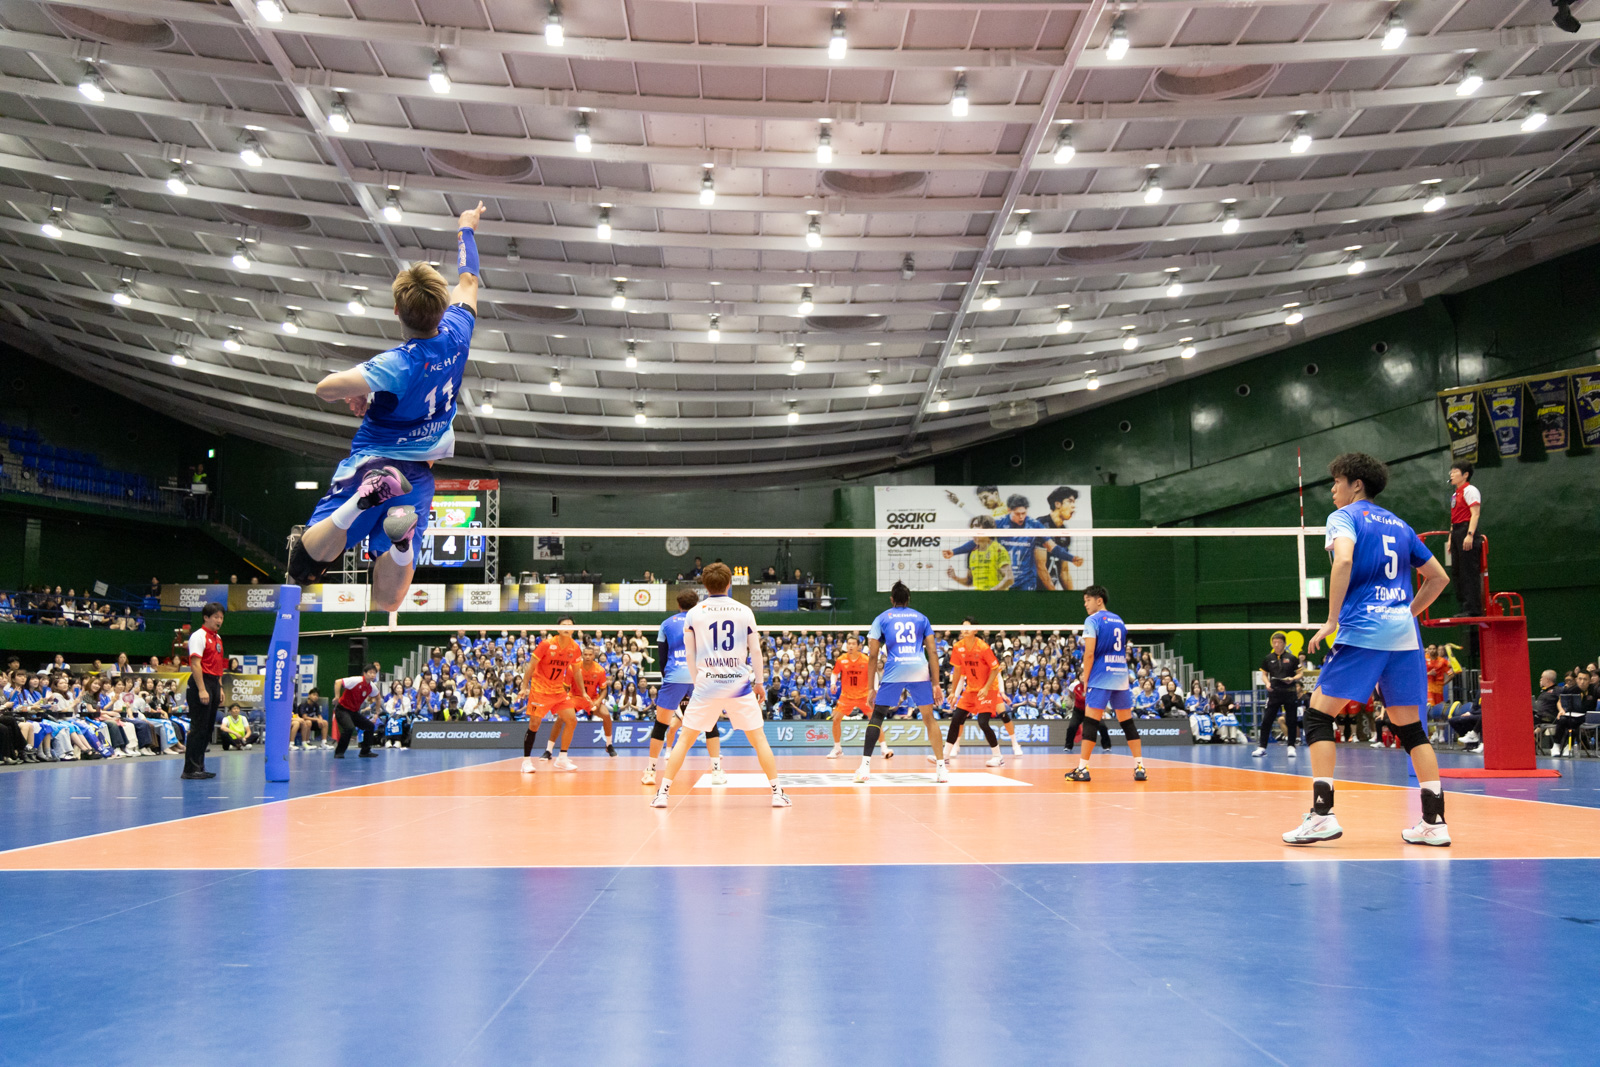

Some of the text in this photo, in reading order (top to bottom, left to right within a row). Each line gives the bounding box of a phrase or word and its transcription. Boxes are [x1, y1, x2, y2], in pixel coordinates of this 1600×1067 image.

[424, 376, 454, 420] 11
[1382, 534, 1398, 580] 5
[709, 620, 734, 651] 13
[894, 622, 916, 643] 23
[1114, 628, 1122, 652] 3
[274, 660, 285, 700] Senoh
[550, 668, 562, 680] 17
[776, 727, 794, 741] VS
